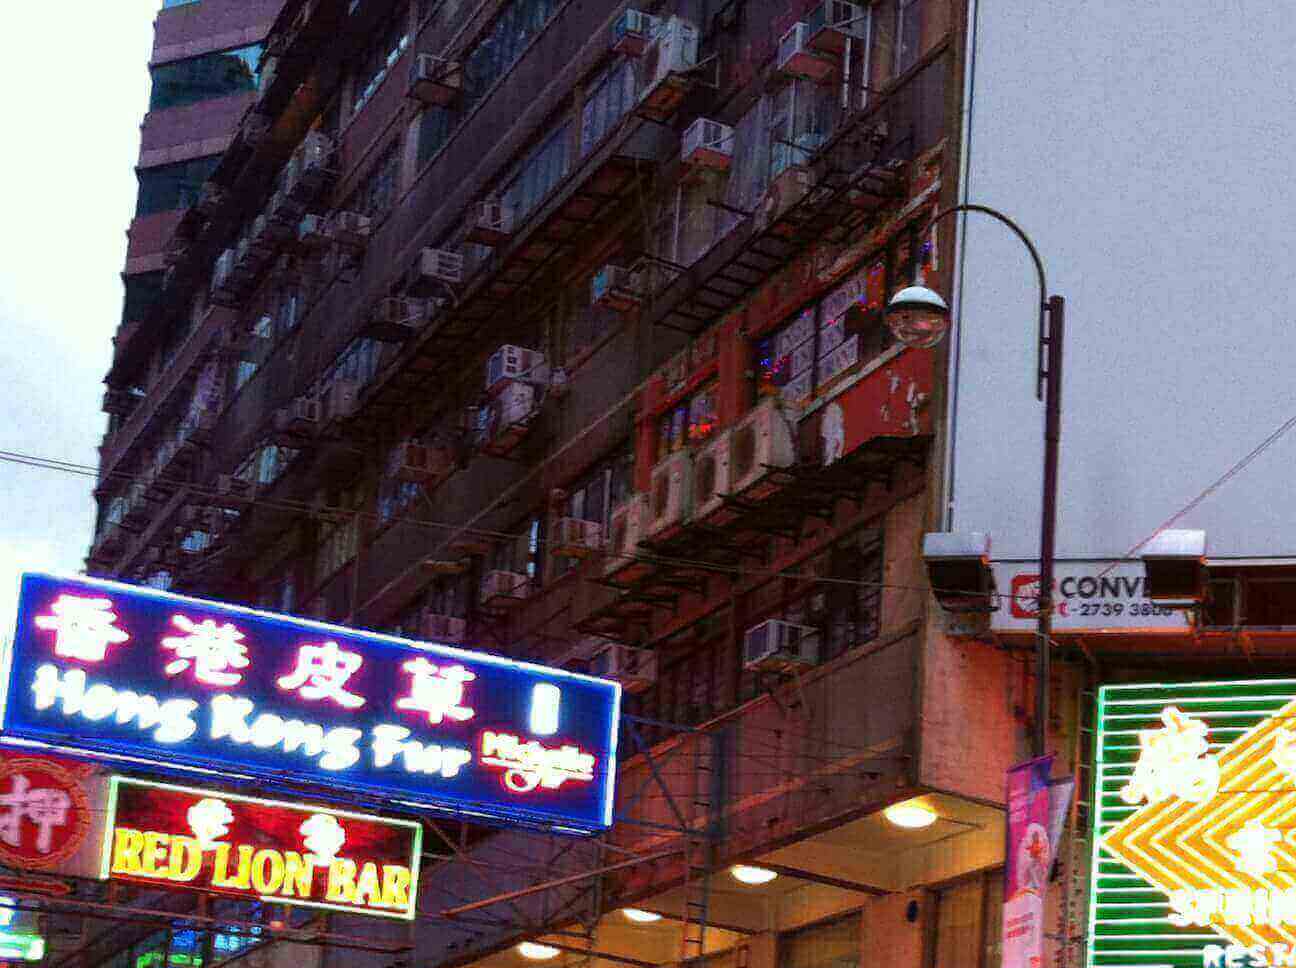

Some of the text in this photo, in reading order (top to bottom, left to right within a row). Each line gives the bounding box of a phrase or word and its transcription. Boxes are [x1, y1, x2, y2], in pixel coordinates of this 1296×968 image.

[34, 593, 476, 725] 香港皮草
[32, 663, 199, 743] Hong
[210, 695, 362, 772] Kong
[371, 725, 472, 778] Fur
[112, 827, 202, 882] RED
[212, 843, 315, 900] LION
[325, 856, 413, 908] BAR
